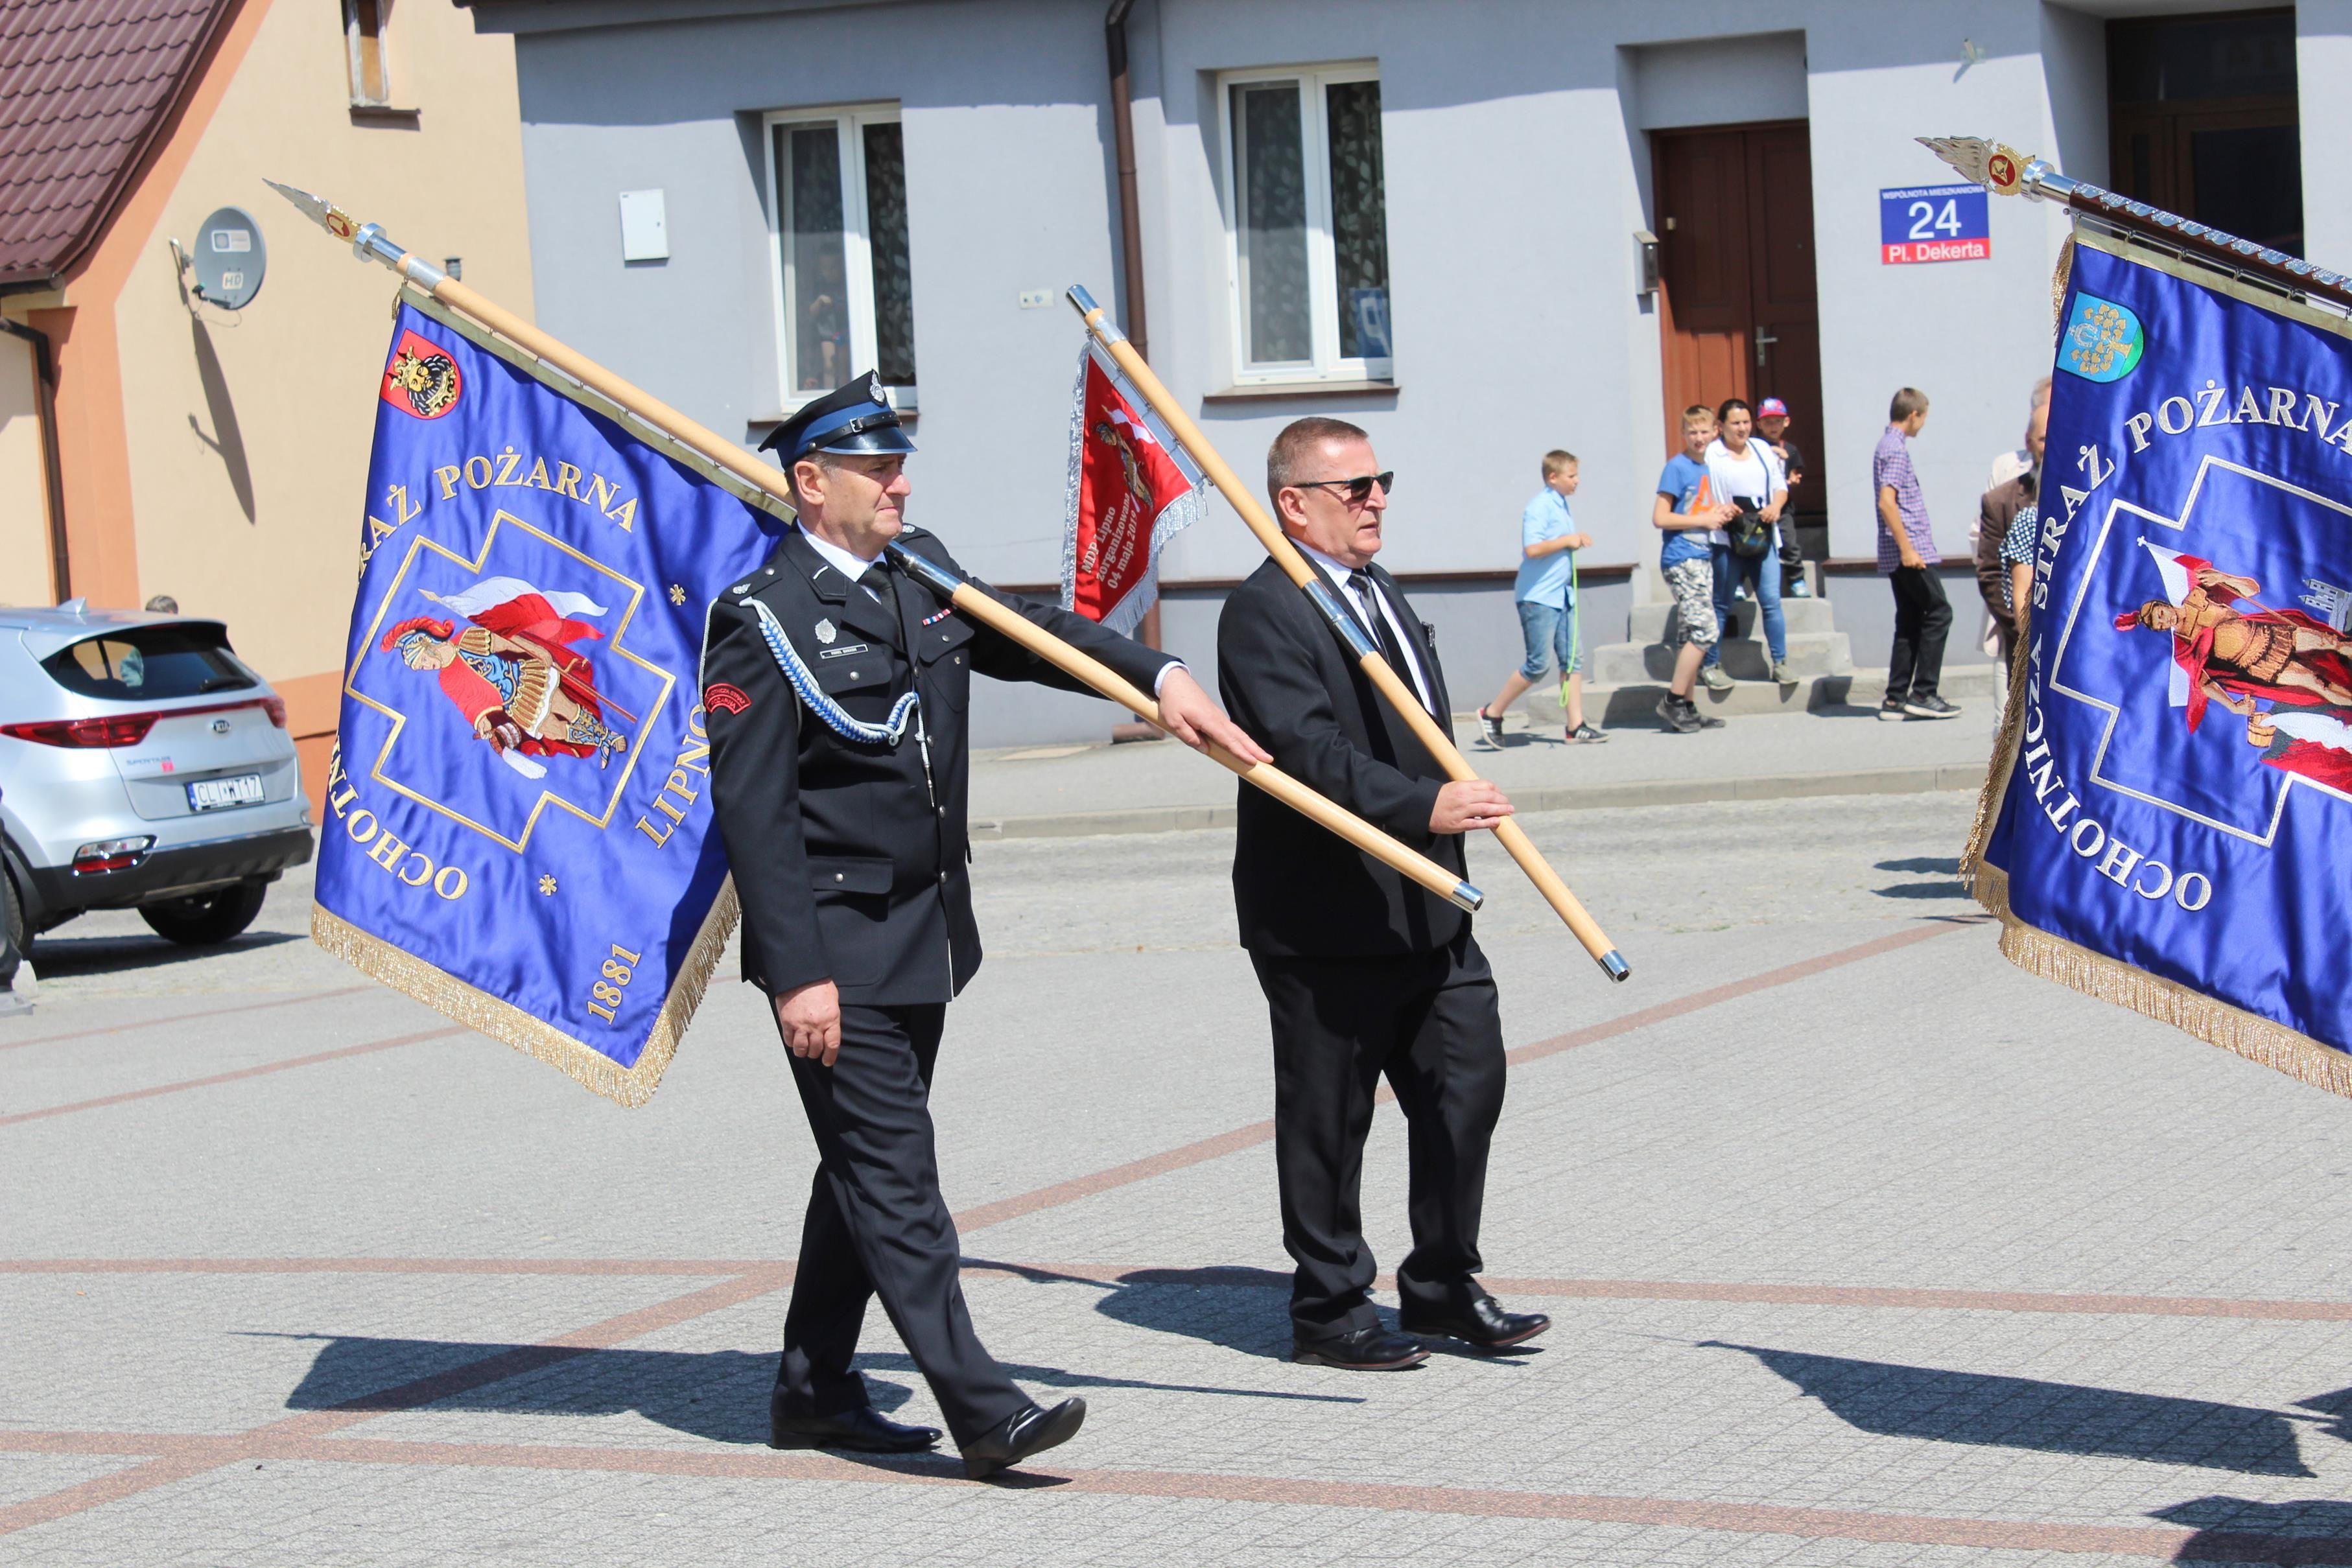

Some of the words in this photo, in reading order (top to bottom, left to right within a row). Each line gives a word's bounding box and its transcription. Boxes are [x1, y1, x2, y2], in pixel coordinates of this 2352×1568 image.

[1882, 189, 1929, 200] WSPÓLNOTA
[1929, 185, 1986, 196] MIESZKANIOWA
[1908, 198, 1962, 240] 24
[225, 275, 241, 287] HD
[1888, 245, 1911, 263] Pl.
[1916, 242, 1984, 261] Dekerta
[2125, 379, 2352, 456] POŻARNA
[433, 445, 639, 533] POŻARNA
[2033, 444, 2115, 610] STRAŻ
[1081, 541, 1100, 574] MDP
[1093, 506, 1116, 544] Lipno
[1096, 492, 1131, 581] zorganizowana
[1107, 571, 1122, 589] 04
[1117, 541, 1135, 572] maja
[1127, 509, 1138, 541] 2019
[215, 721, 229, 732] KIA
[2024, 633, 2212, 911] OCHOTNICZA
[586, 943, 642, 1025] 1881
